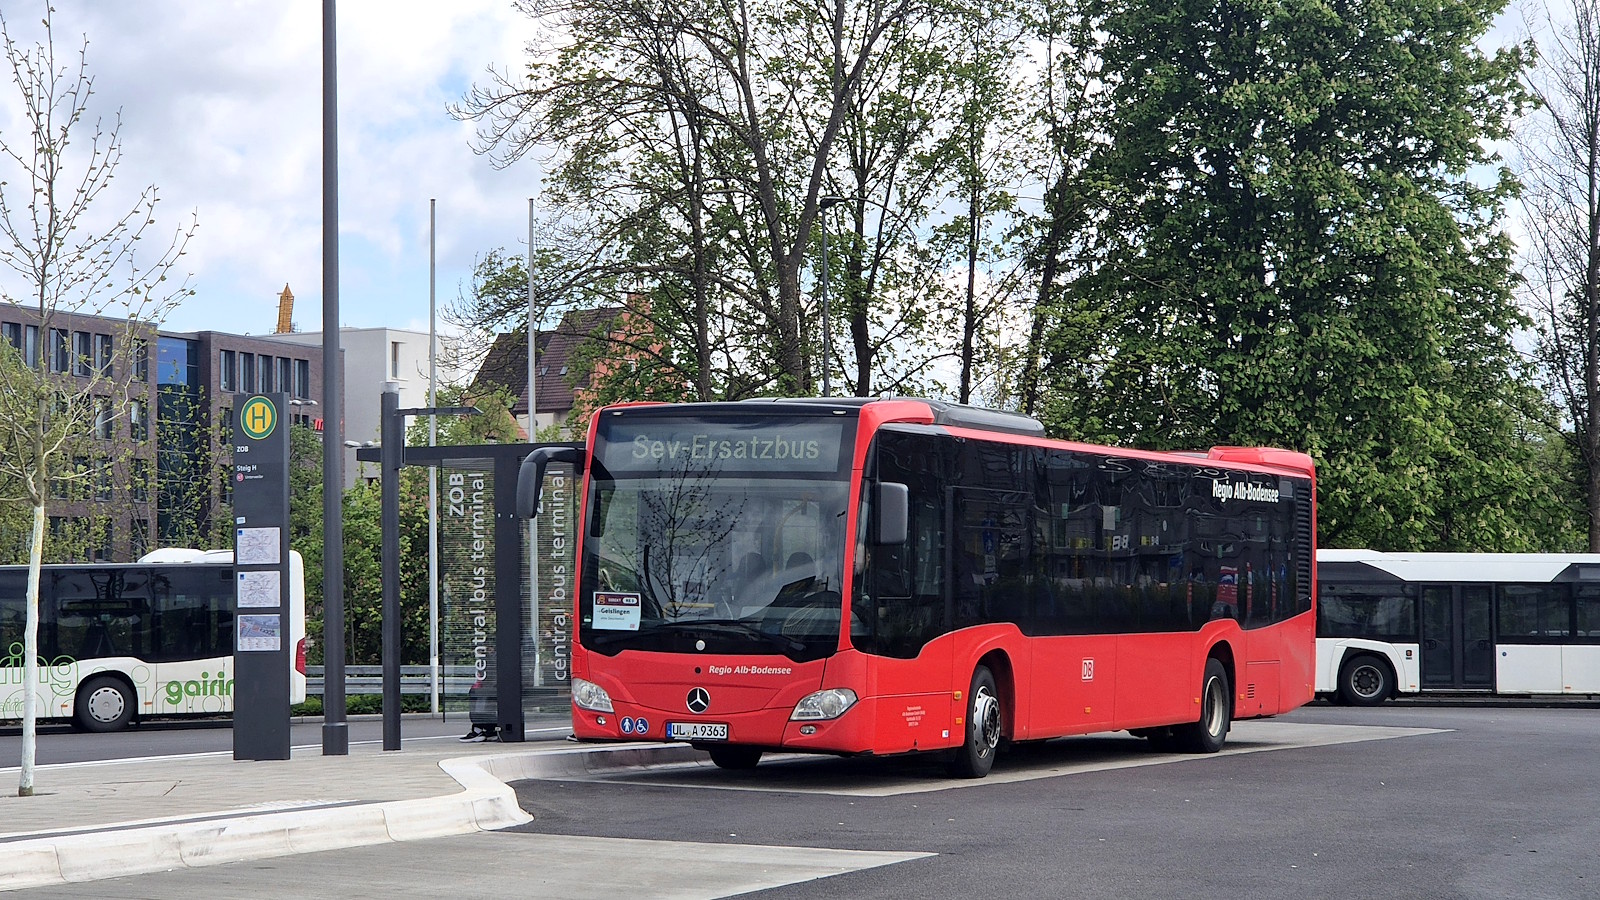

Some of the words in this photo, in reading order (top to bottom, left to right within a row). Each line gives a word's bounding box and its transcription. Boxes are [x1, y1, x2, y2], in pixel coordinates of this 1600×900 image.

[252, 406, 266, 429] H
[632, 434, 820, 459] Sev-Ersatzbus
[450, 473, 464, 517] ZOB
[1212, 480, 1233, 502] Regio
[1233, 482, 1279, 502] Alb-Bodensee
[468, 473, 485, 560] terminal
[548, 470, 564, 559] terminal
[469, 566, 485, 601] bus
[550, 564, 565, 600] bus
[470, 610, 486, 680] central
[550, 608, 566, 680] central
[709, 666, 732, 675] Regio
[734, 666, 792, 675] Alb-Bodensee
[1083, 661, 1093, 678] DB
[672, 725, 686, 735] UL
[692, 726, 698, 736] A
[700, 726, 725, 736] 9363
